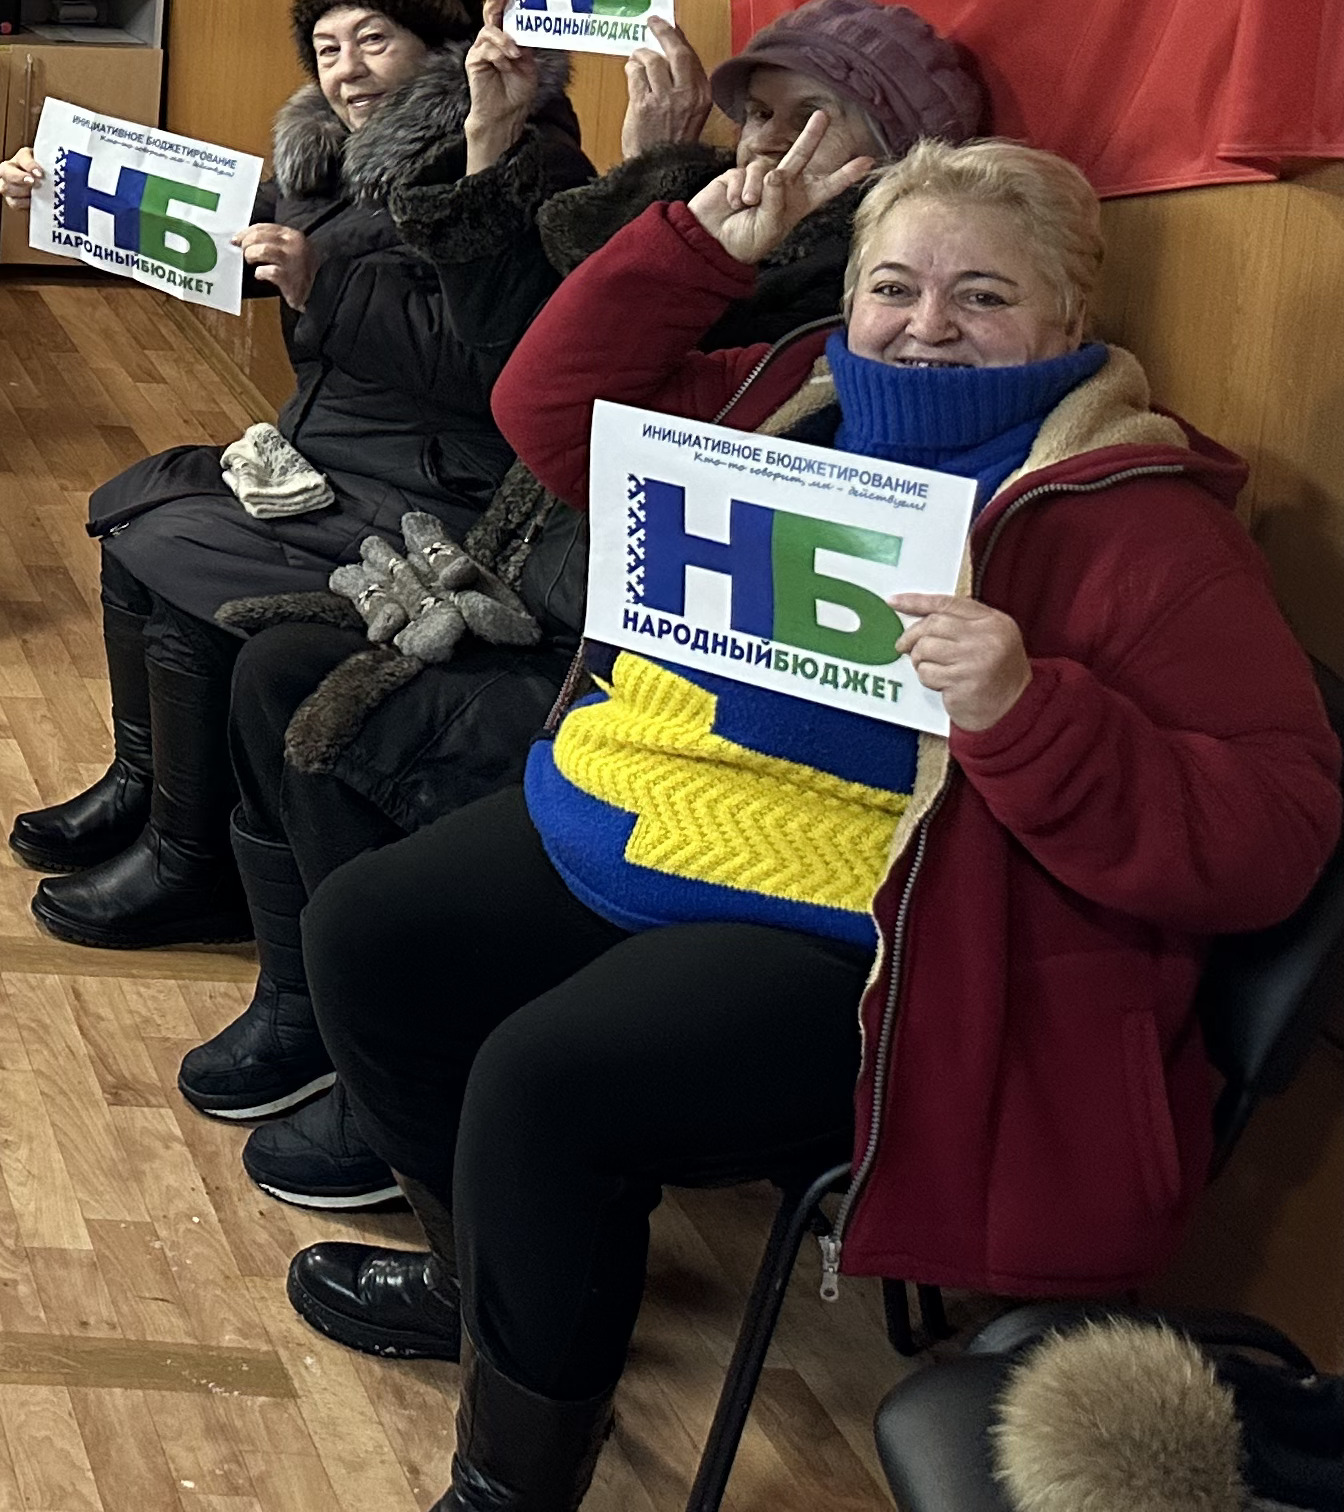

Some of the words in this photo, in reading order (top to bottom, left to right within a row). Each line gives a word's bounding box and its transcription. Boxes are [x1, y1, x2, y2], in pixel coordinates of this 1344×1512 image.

[515, 14, 647, 42] НАРОДНЫЙБЮДЖЕТ
[146, 135, 237, 169] БЮДЖЕТИРОВАНИЕ
[54, 146, 220, 274] НБ
[52, 231, 213, 296] НАРОДНЫЙБЮДЖЕТ
[642, 423, 762, 462] ИНИЦИАТИВНОЕ
[766, 451, 929, 498] БЮДЖЕТИРОВАНИЕ
[627, 473, 906, 666] НБ
[622, 608, 903, 704] НАРОДНЫЙБЮДЖЕТ
